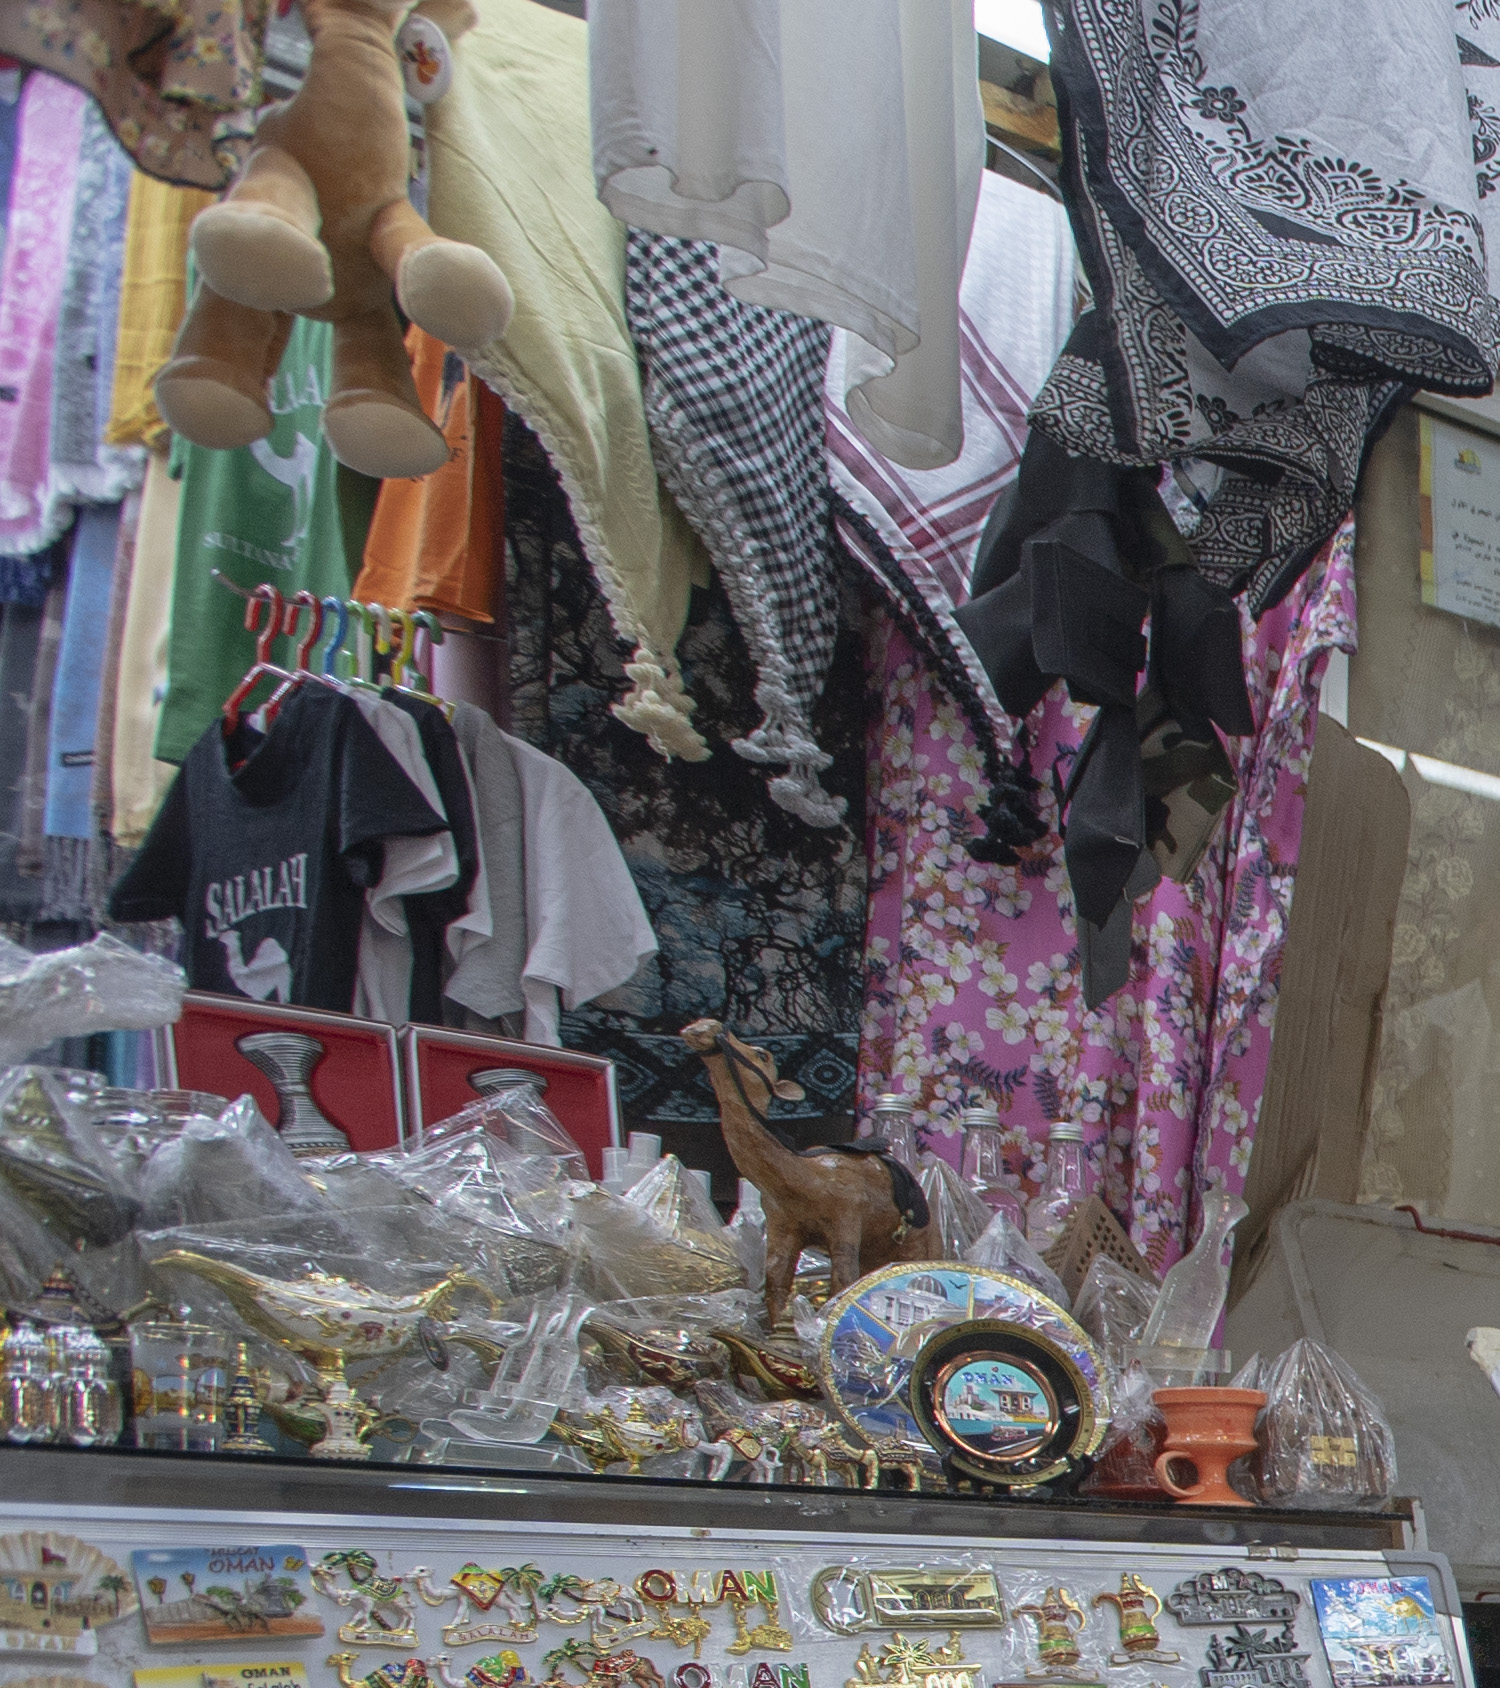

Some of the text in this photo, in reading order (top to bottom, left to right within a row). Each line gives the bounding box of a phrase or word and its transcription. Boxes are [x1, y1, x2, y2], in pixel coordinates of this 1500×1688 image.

[205, 853, 308, 940] SALALAH
[964, 1370, 1016, 1386] OMAN
[209, 1557, 274, 1574] OMAN
[641, 1569, 779, 1603] OMAN
[1355, 1580, 1404, 1596] OMAN
[458, 1630, 530, 1643] SALALAH
[242, 1667, 291, 1680] OMAN
